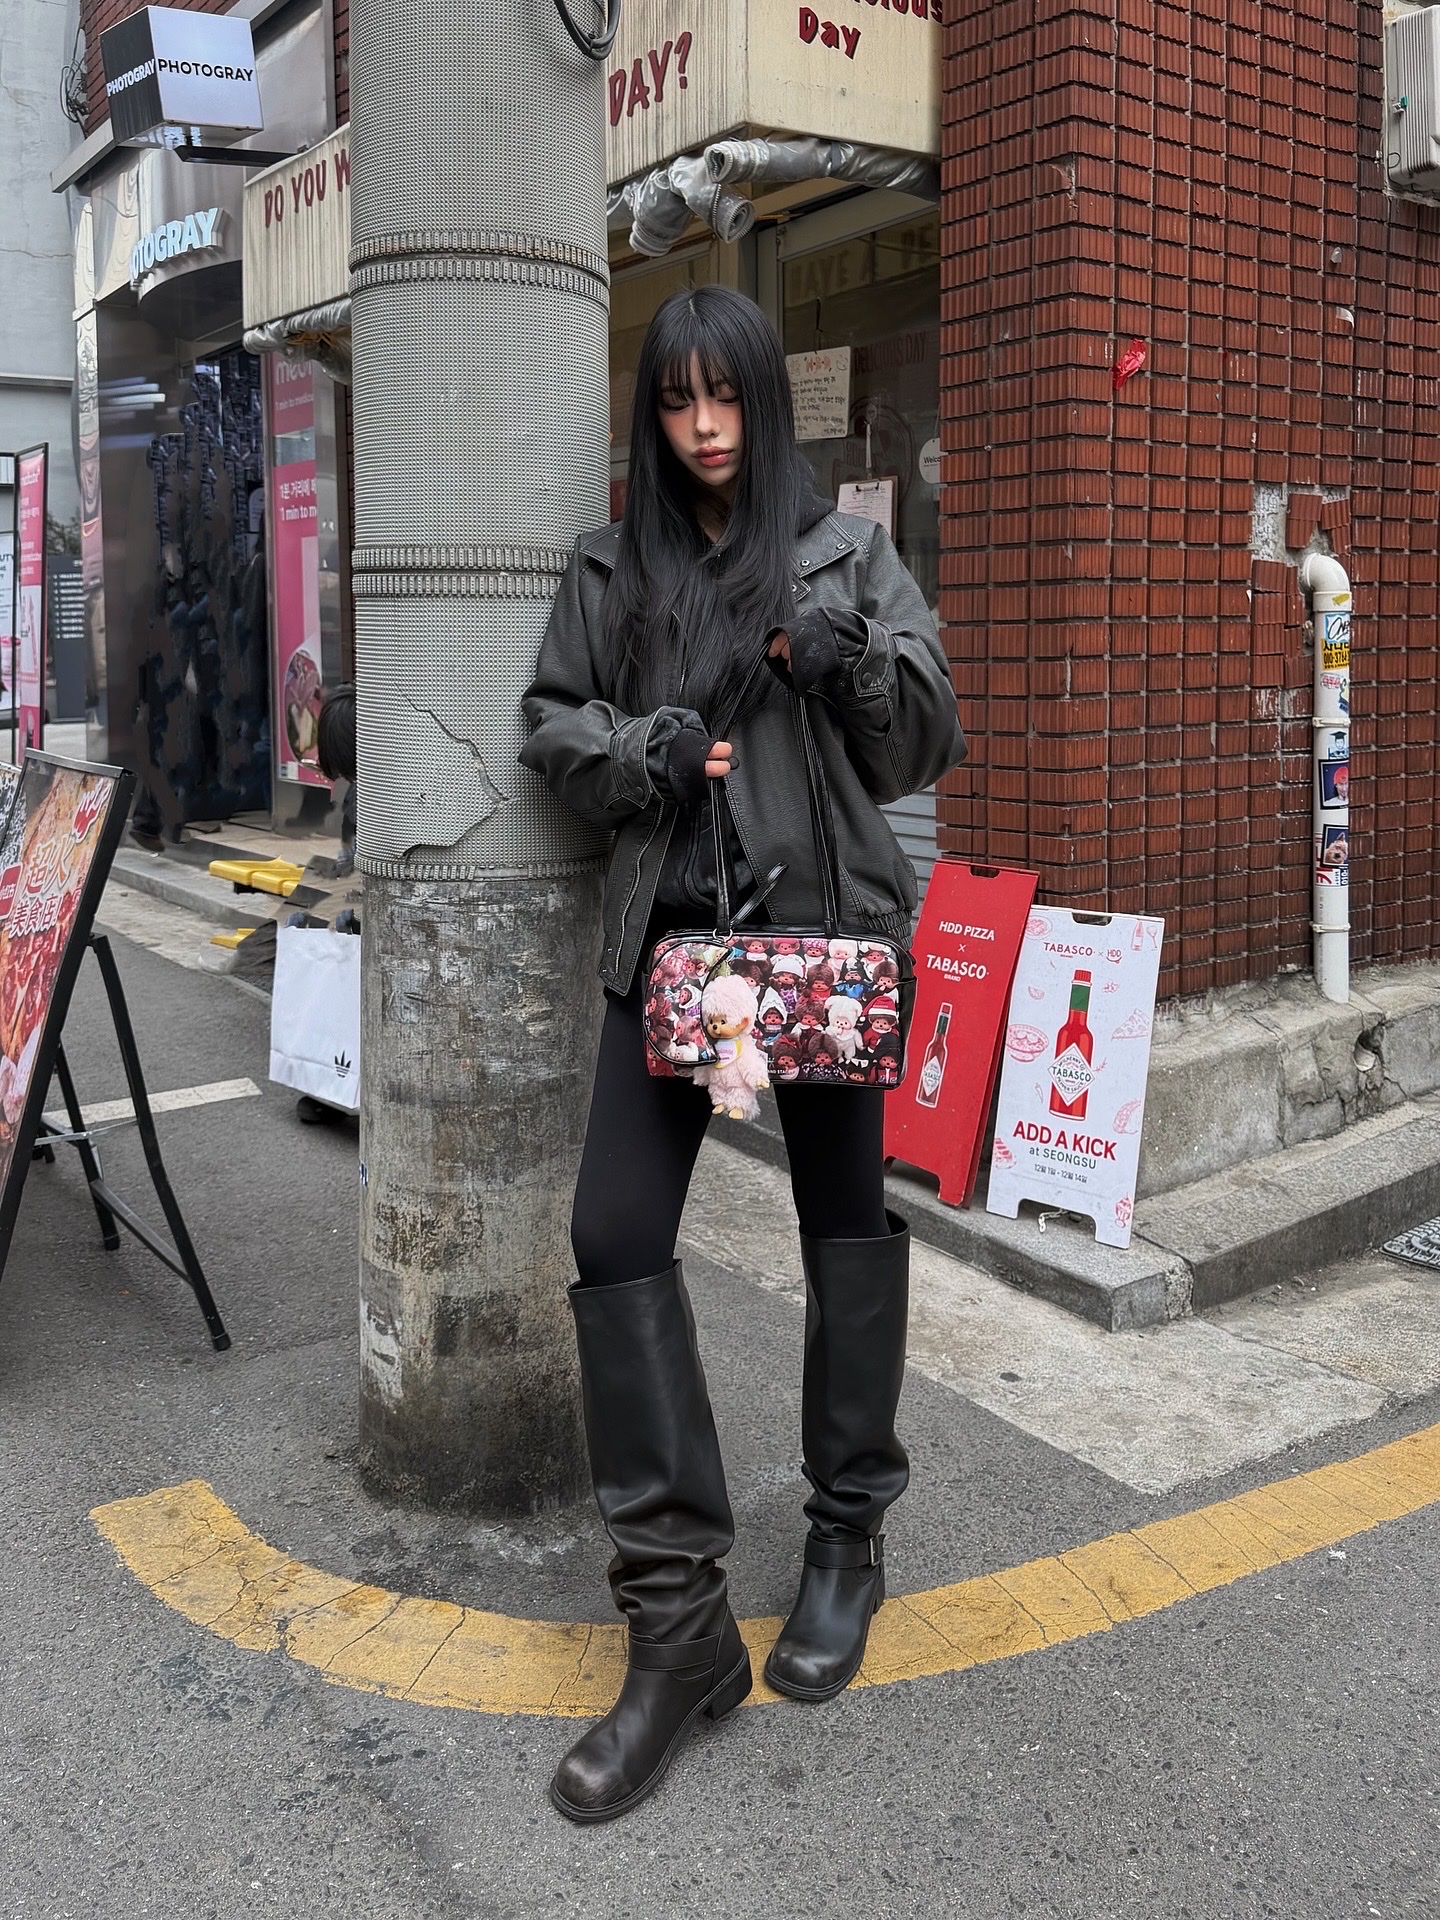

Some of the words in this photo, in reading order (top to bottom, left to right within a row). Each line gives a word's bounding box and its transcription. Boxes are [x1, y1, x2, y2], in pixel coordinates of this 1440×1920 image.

[799, 6, 861, 60] Day
[106, 58, 155, 97] PHOTOGRAY
[157, 58, 254, 82] PHOTOGRAY
[609, 31, 692, 127] DAY?
[264, 184, 285, 229] DO
[291, 159, 327, 214] YOU
[938, 921, 963, 934] HDD
[963, 925, 995, 941] PIZZA
[1043, 942, 1093, 956] TABASCO
[1107, 948, 1122, 958] HDD
[926, 954, 987, 980] TABASCO
[1052, 1066, 1092, 1082] TABASCO
[1013, 1120, 1052, 1144] ADD
[1054, 1130, 1068, 1150] A
[1072, 1133, 1117, 1161] KICK
[1029, 1147, 1040, 1156] at
[1043, 1148, 1097, 1170] SEONGSU
